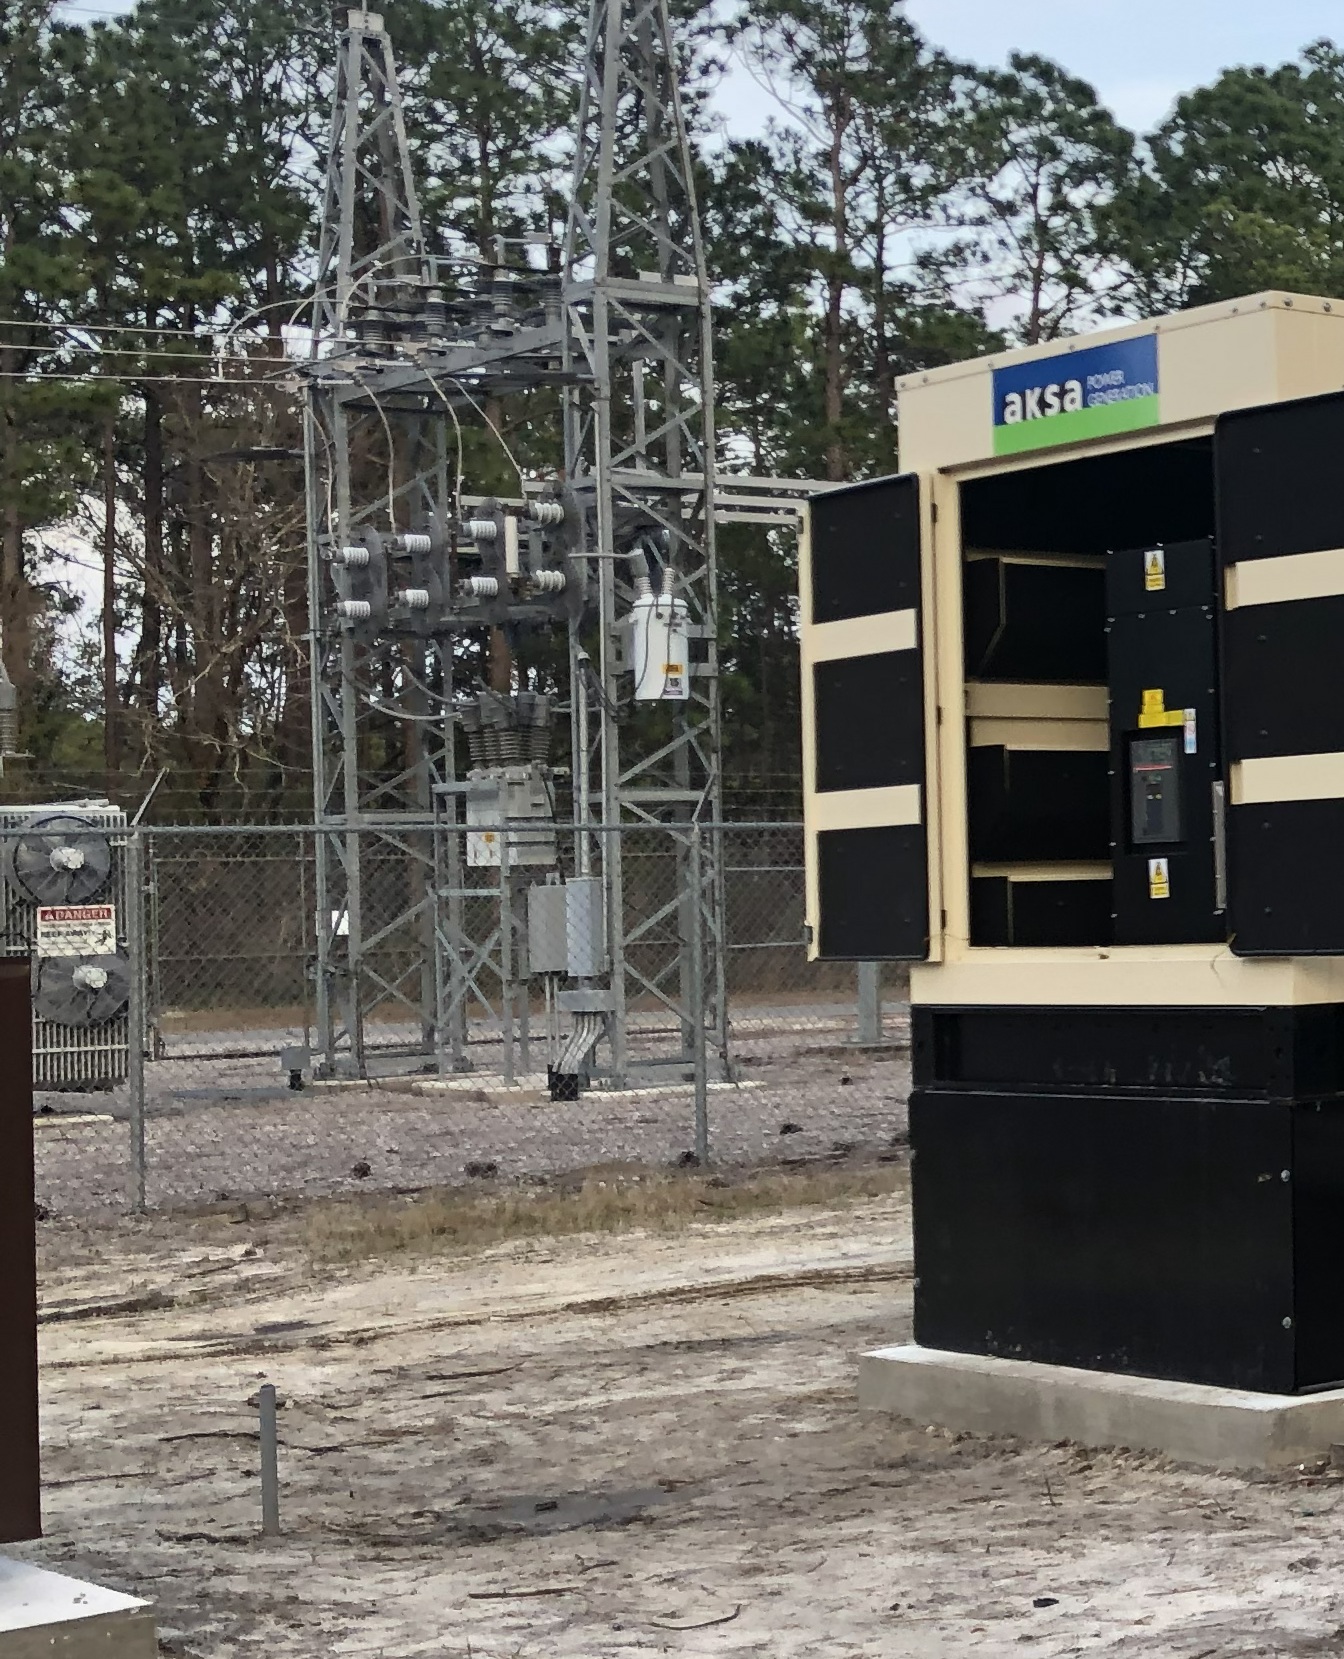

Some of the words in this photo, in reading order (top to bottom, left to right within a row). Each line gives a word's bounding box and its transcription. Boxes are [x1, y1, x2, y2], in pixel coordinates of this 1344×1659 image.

[1086, 369, 1126, 391] POWER
[1003, 379, 1084, 425] aksa
[1087, 382, 1155, 408] GENERATION
[55, 909, 109, 921] DANGER
